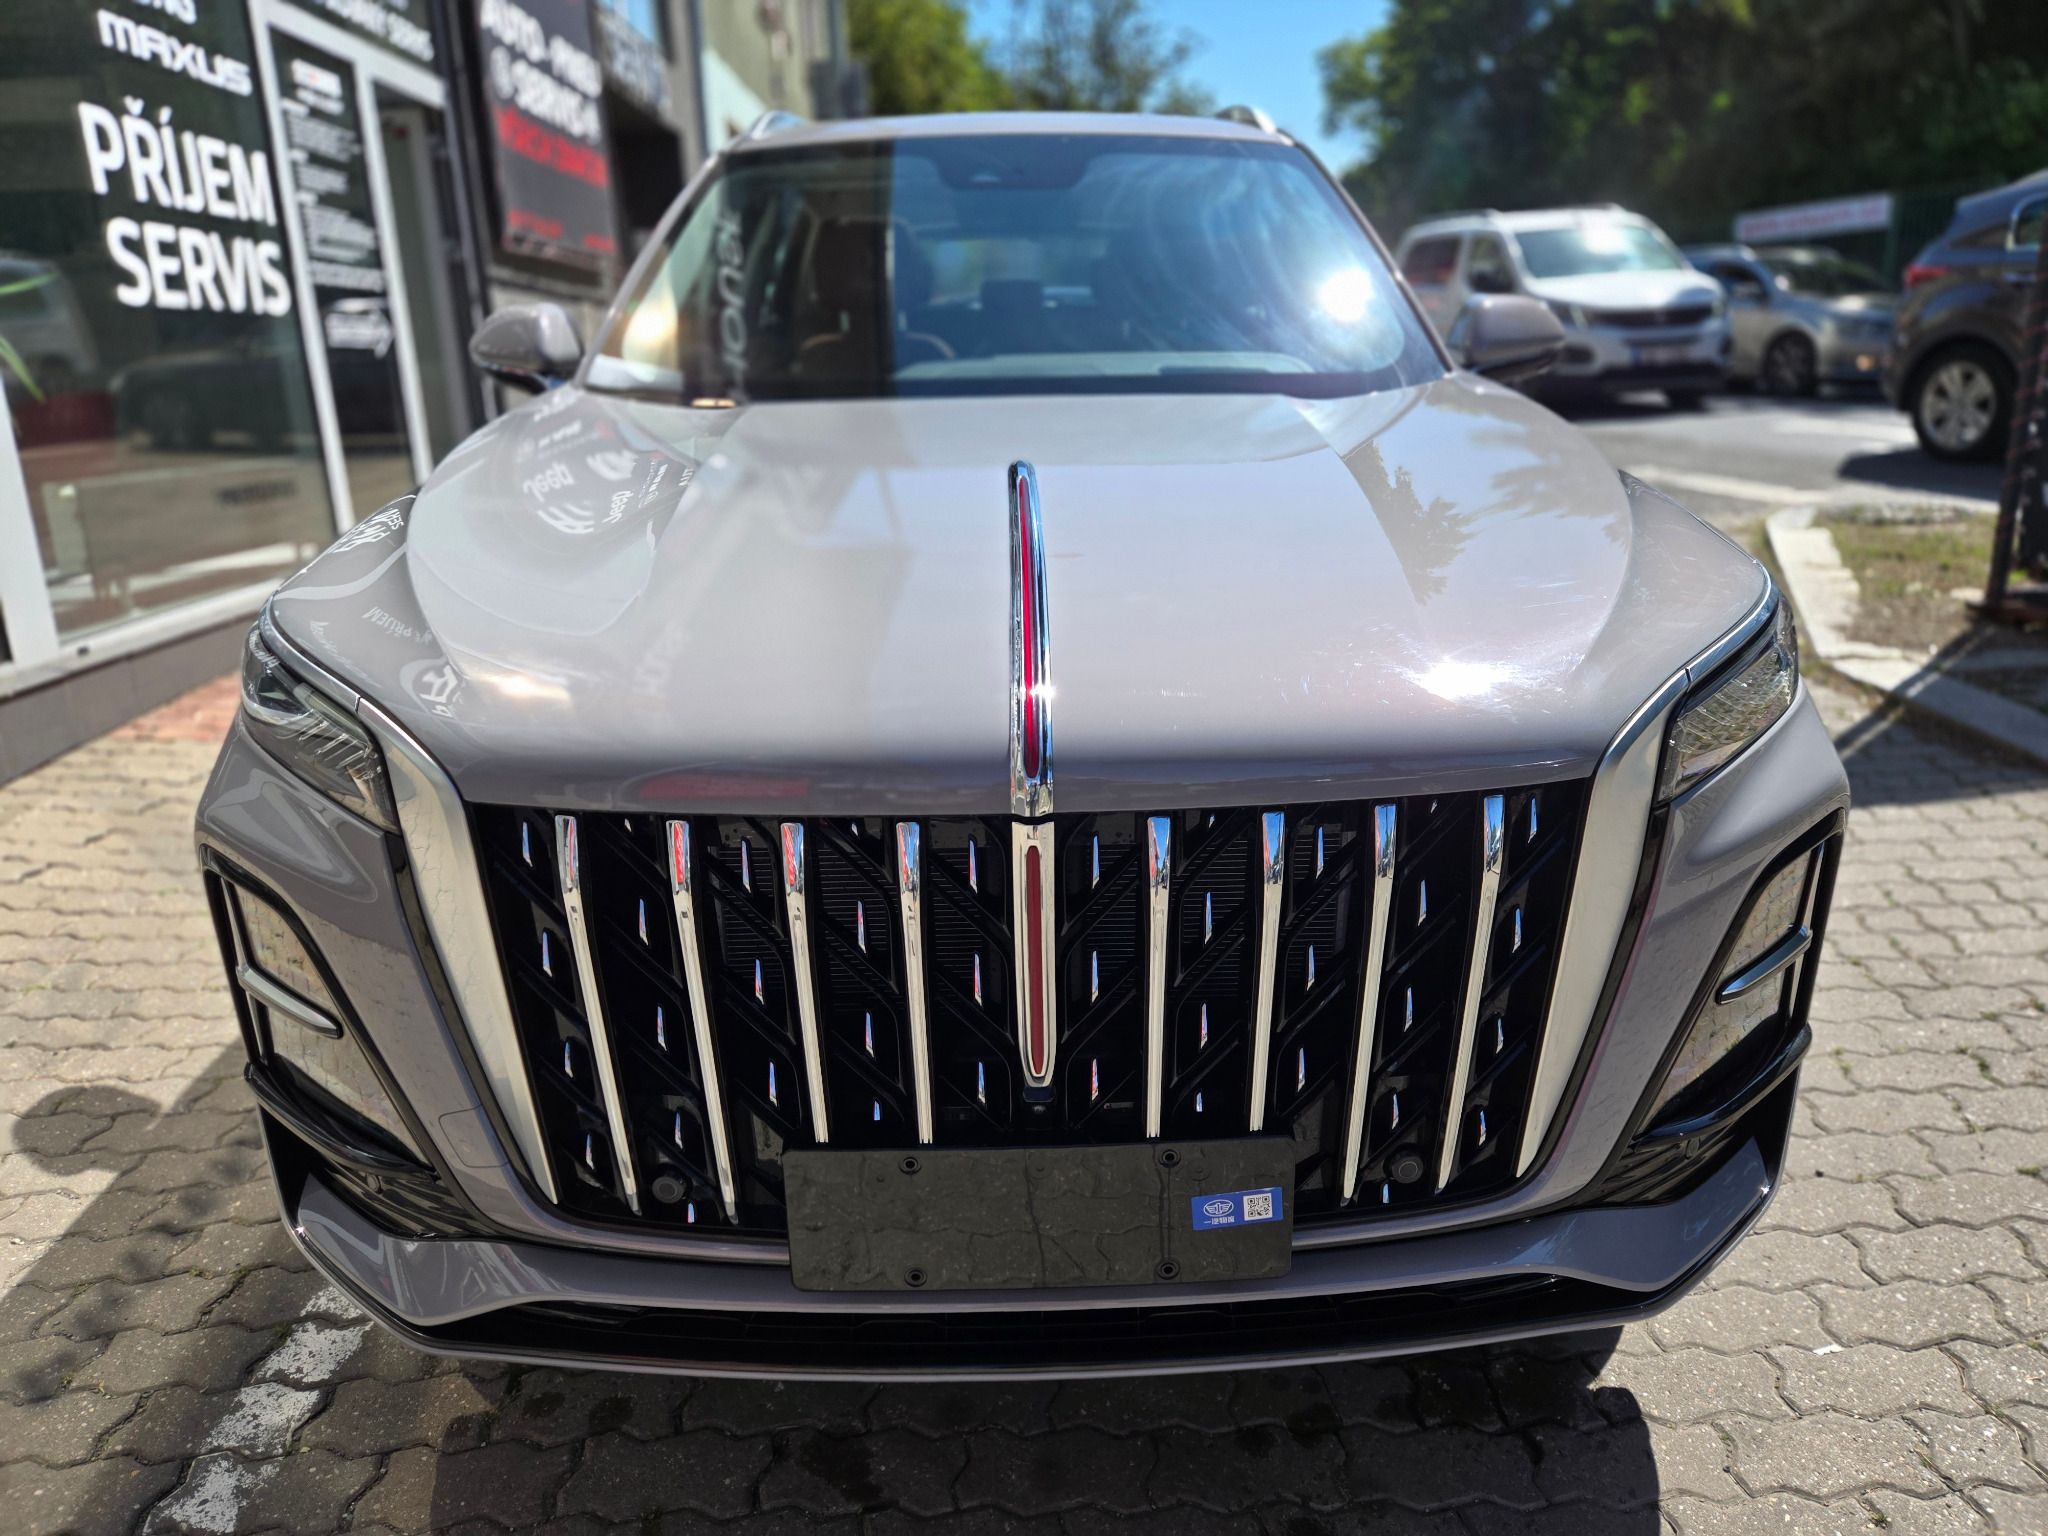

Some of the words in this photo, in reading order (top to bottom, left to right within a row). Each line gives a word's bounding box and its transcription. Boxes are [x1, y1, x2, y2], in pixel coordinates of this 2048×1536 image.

[97, 8, 252, 96] MAXUS
[78, 95, 277, 227] PŘÍJEM
[106, 216, 292, 317] SERVIS
[601, 490, 635, 524] Jeep
[361, 606, 412, 637] PŘÍJEM
